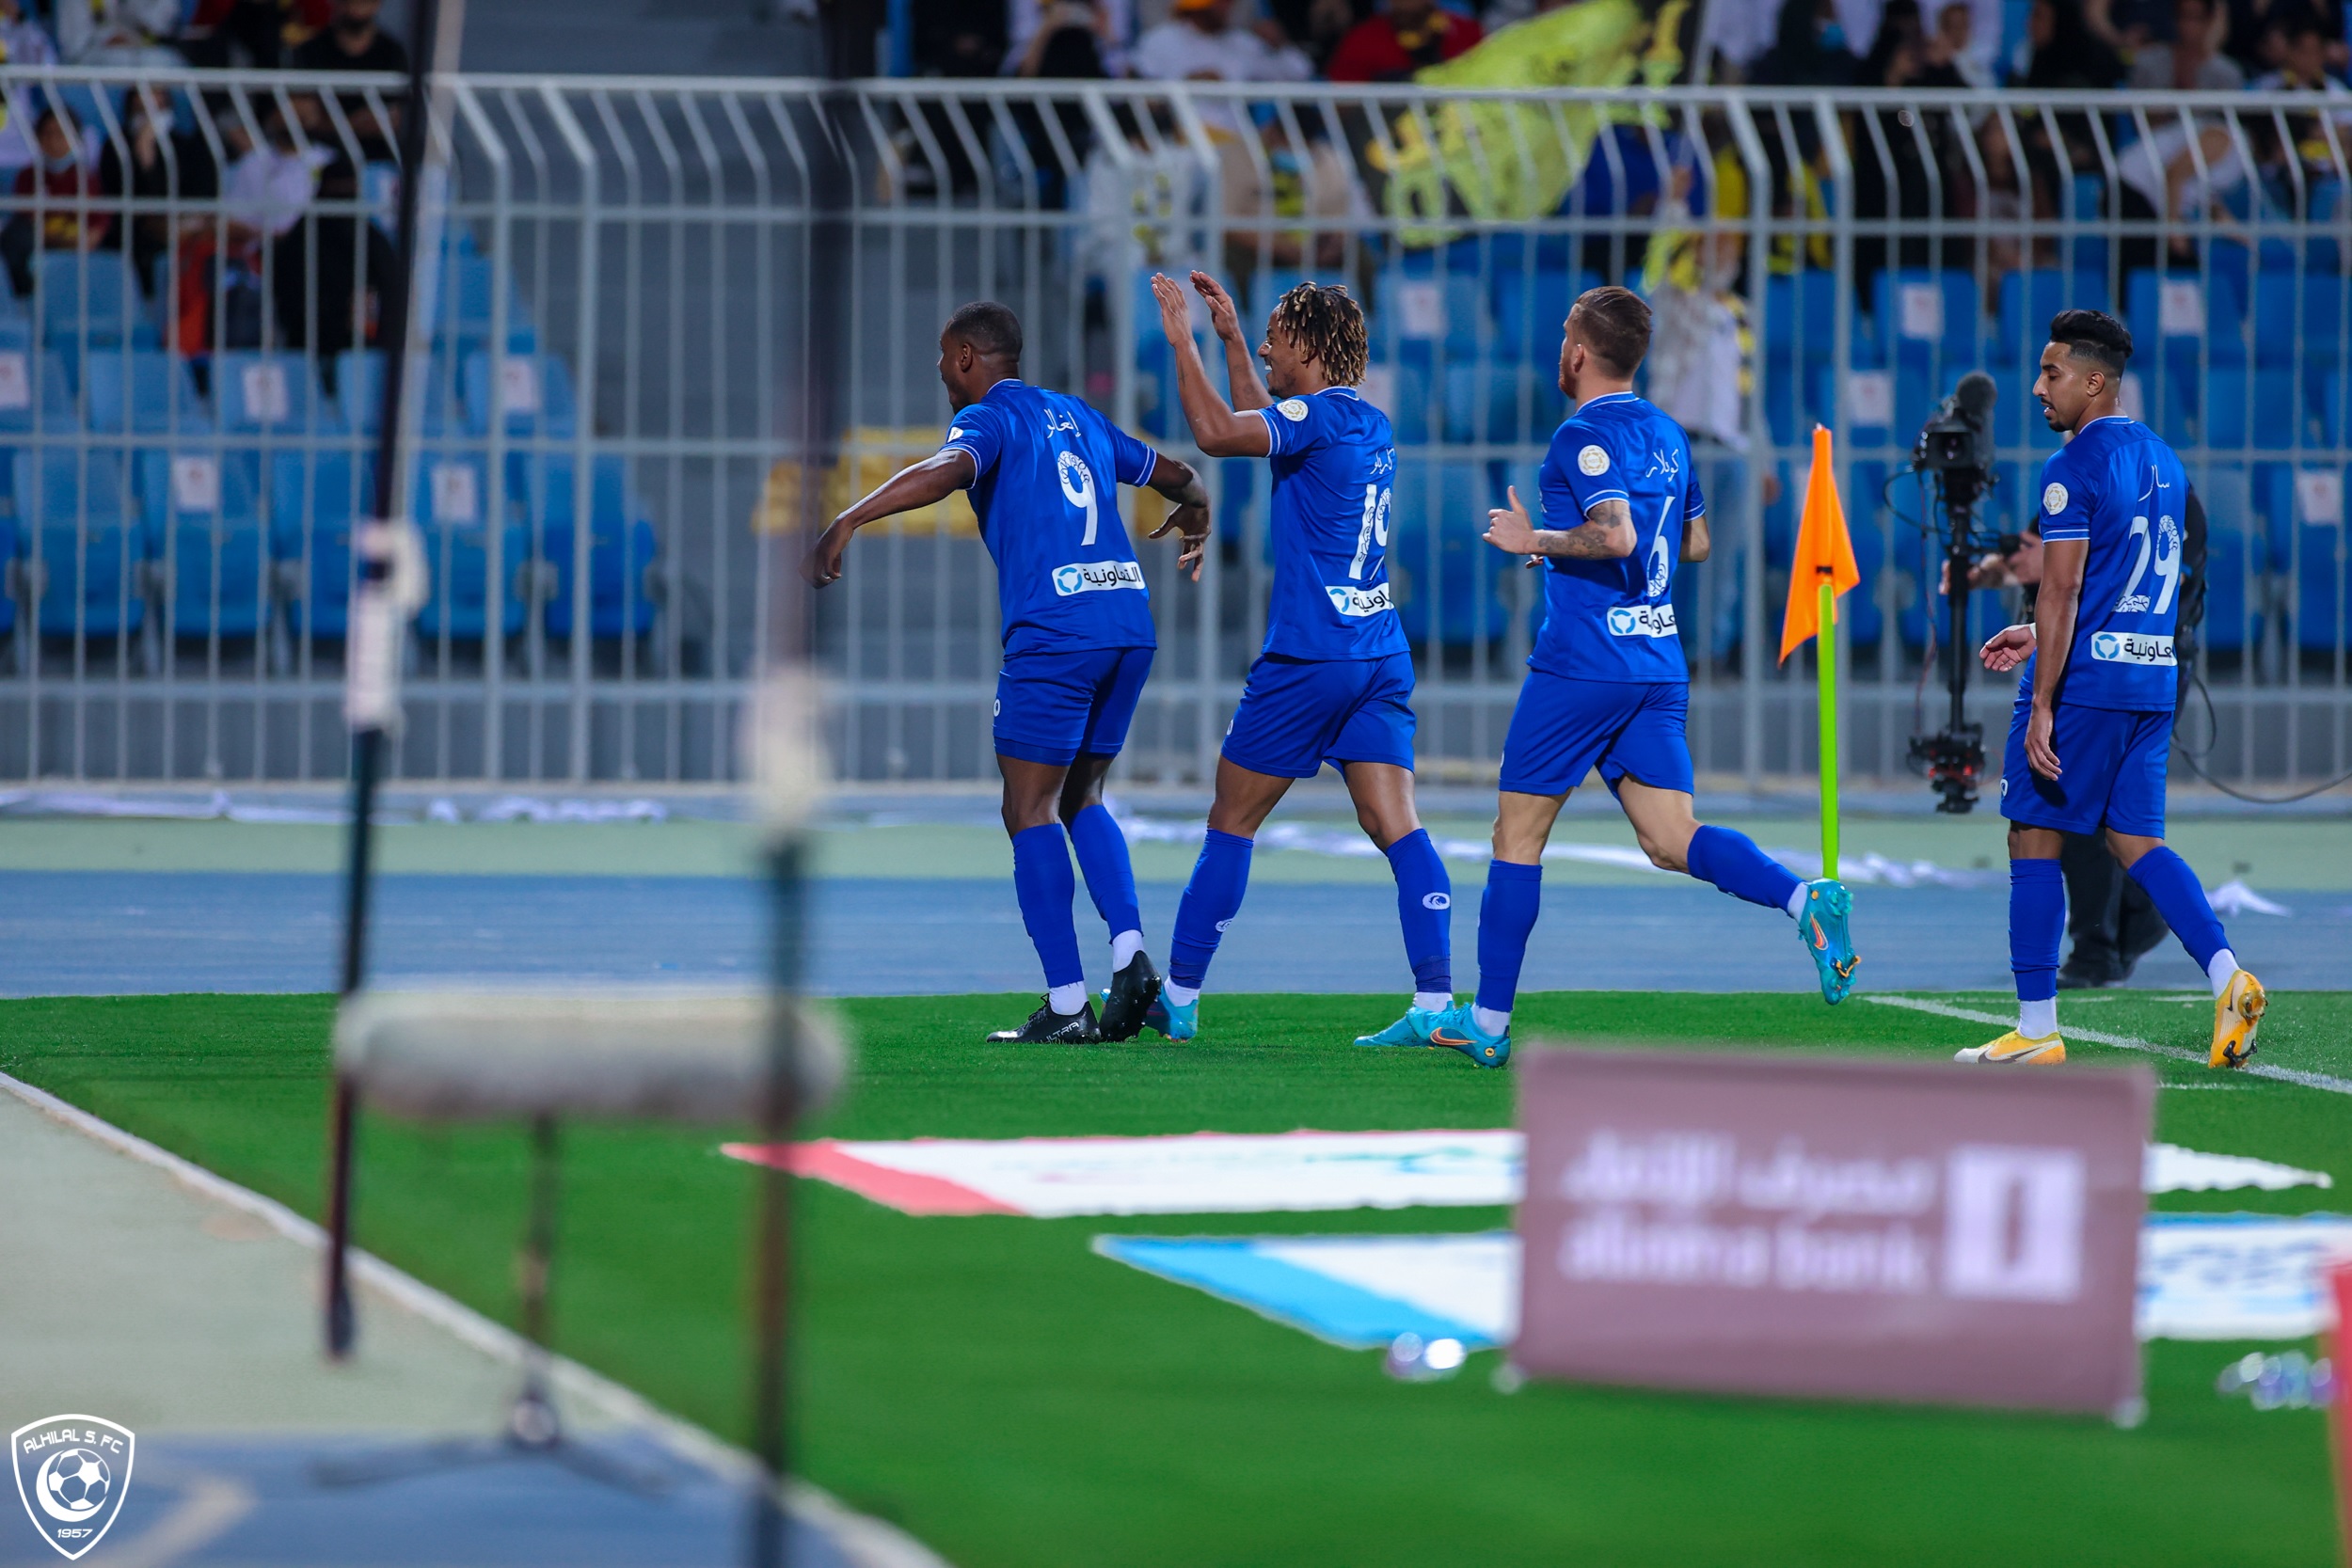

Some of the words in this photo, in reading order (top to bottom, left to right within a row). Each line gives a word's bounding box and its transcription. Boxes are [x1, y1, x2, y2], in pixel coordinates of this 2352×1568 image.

[1057, 451, 1098, 546] 9
[1647, 496, 1677, 597] 6
[2113, 515, 2181, 614] 29
